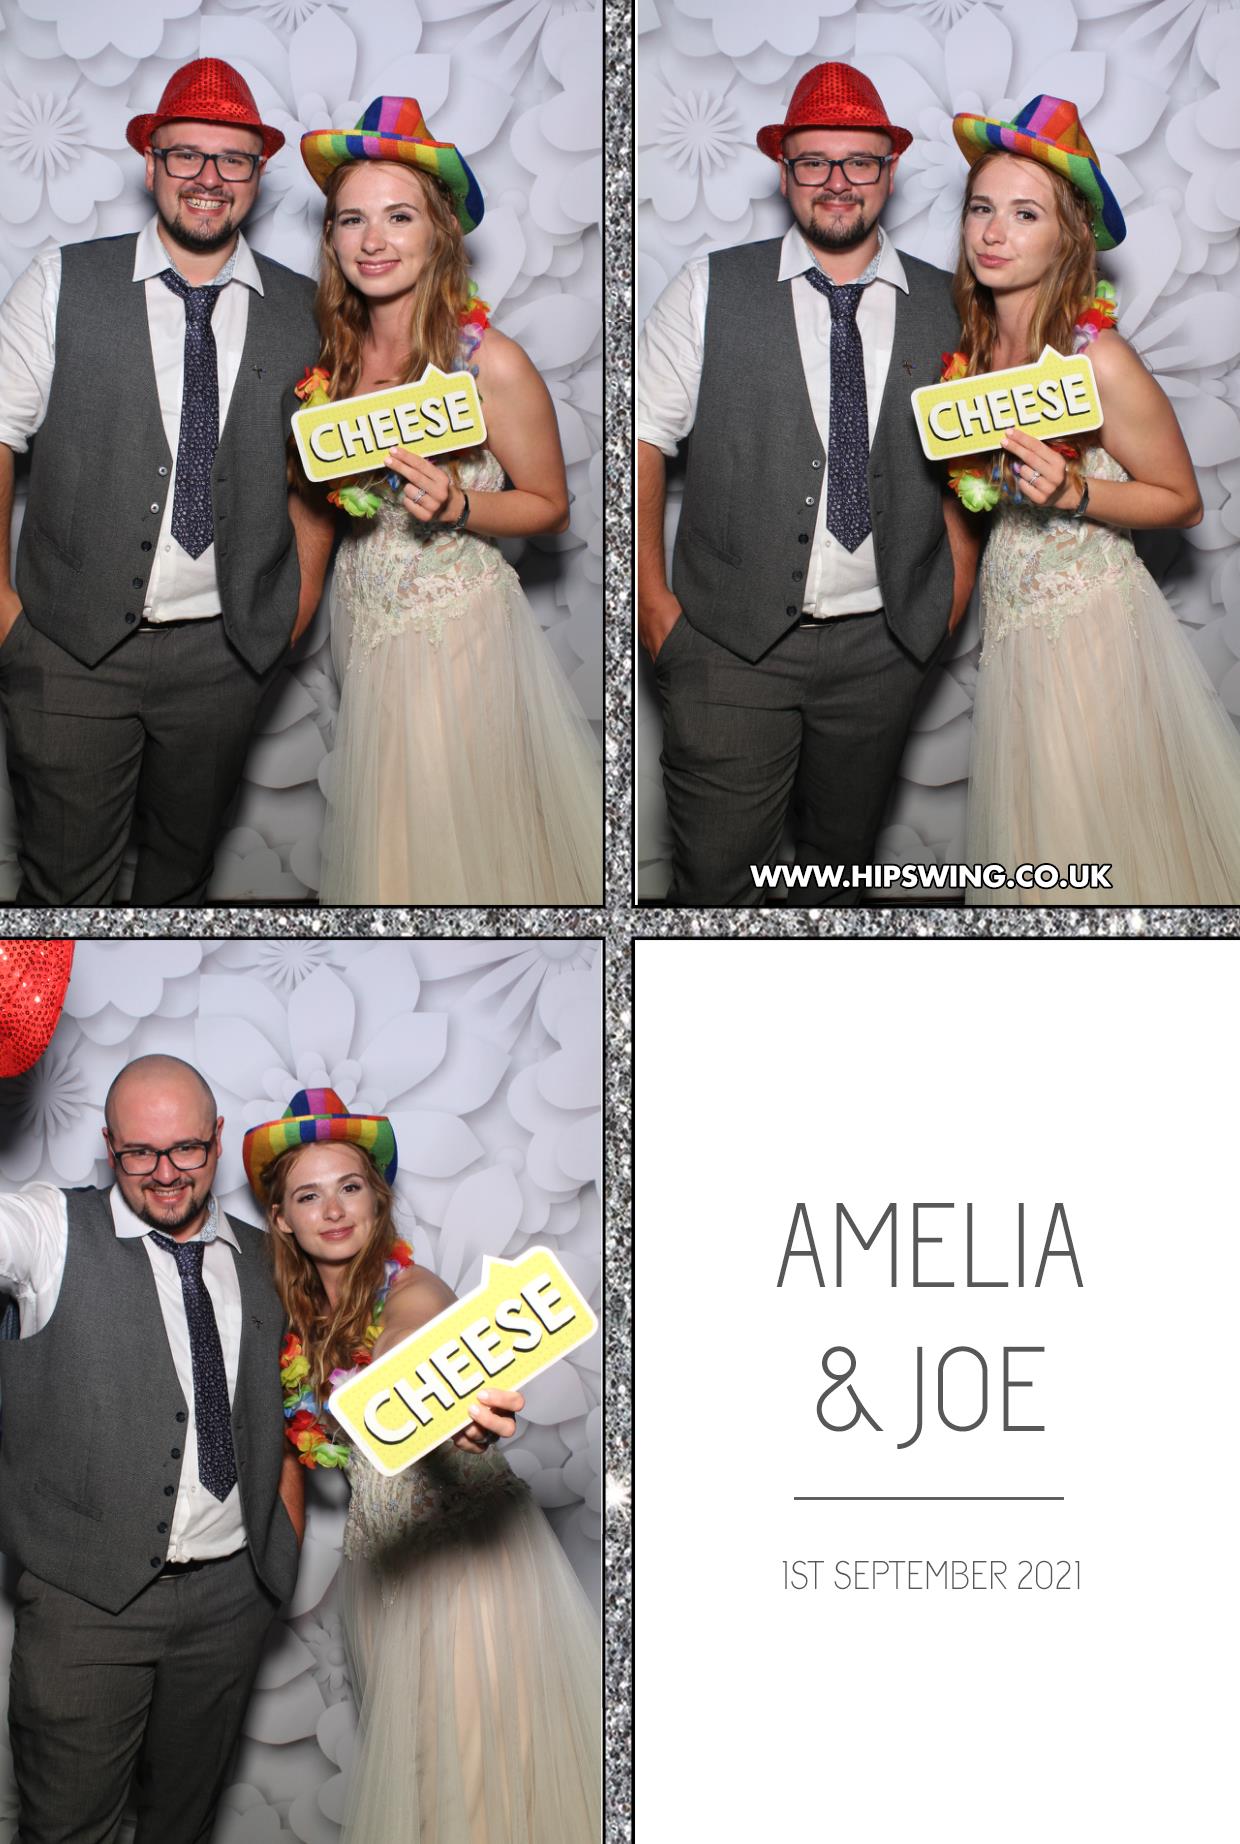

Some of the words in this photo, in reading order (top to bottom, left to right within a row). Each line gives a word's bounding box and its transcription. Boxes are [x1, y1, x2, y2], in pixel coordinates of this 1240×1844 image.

[310, 391, 474, 462] CHEESE
[928, 373, 1091, 441] CHEESE
[363, 1272, 577, 1445] CHEESE
